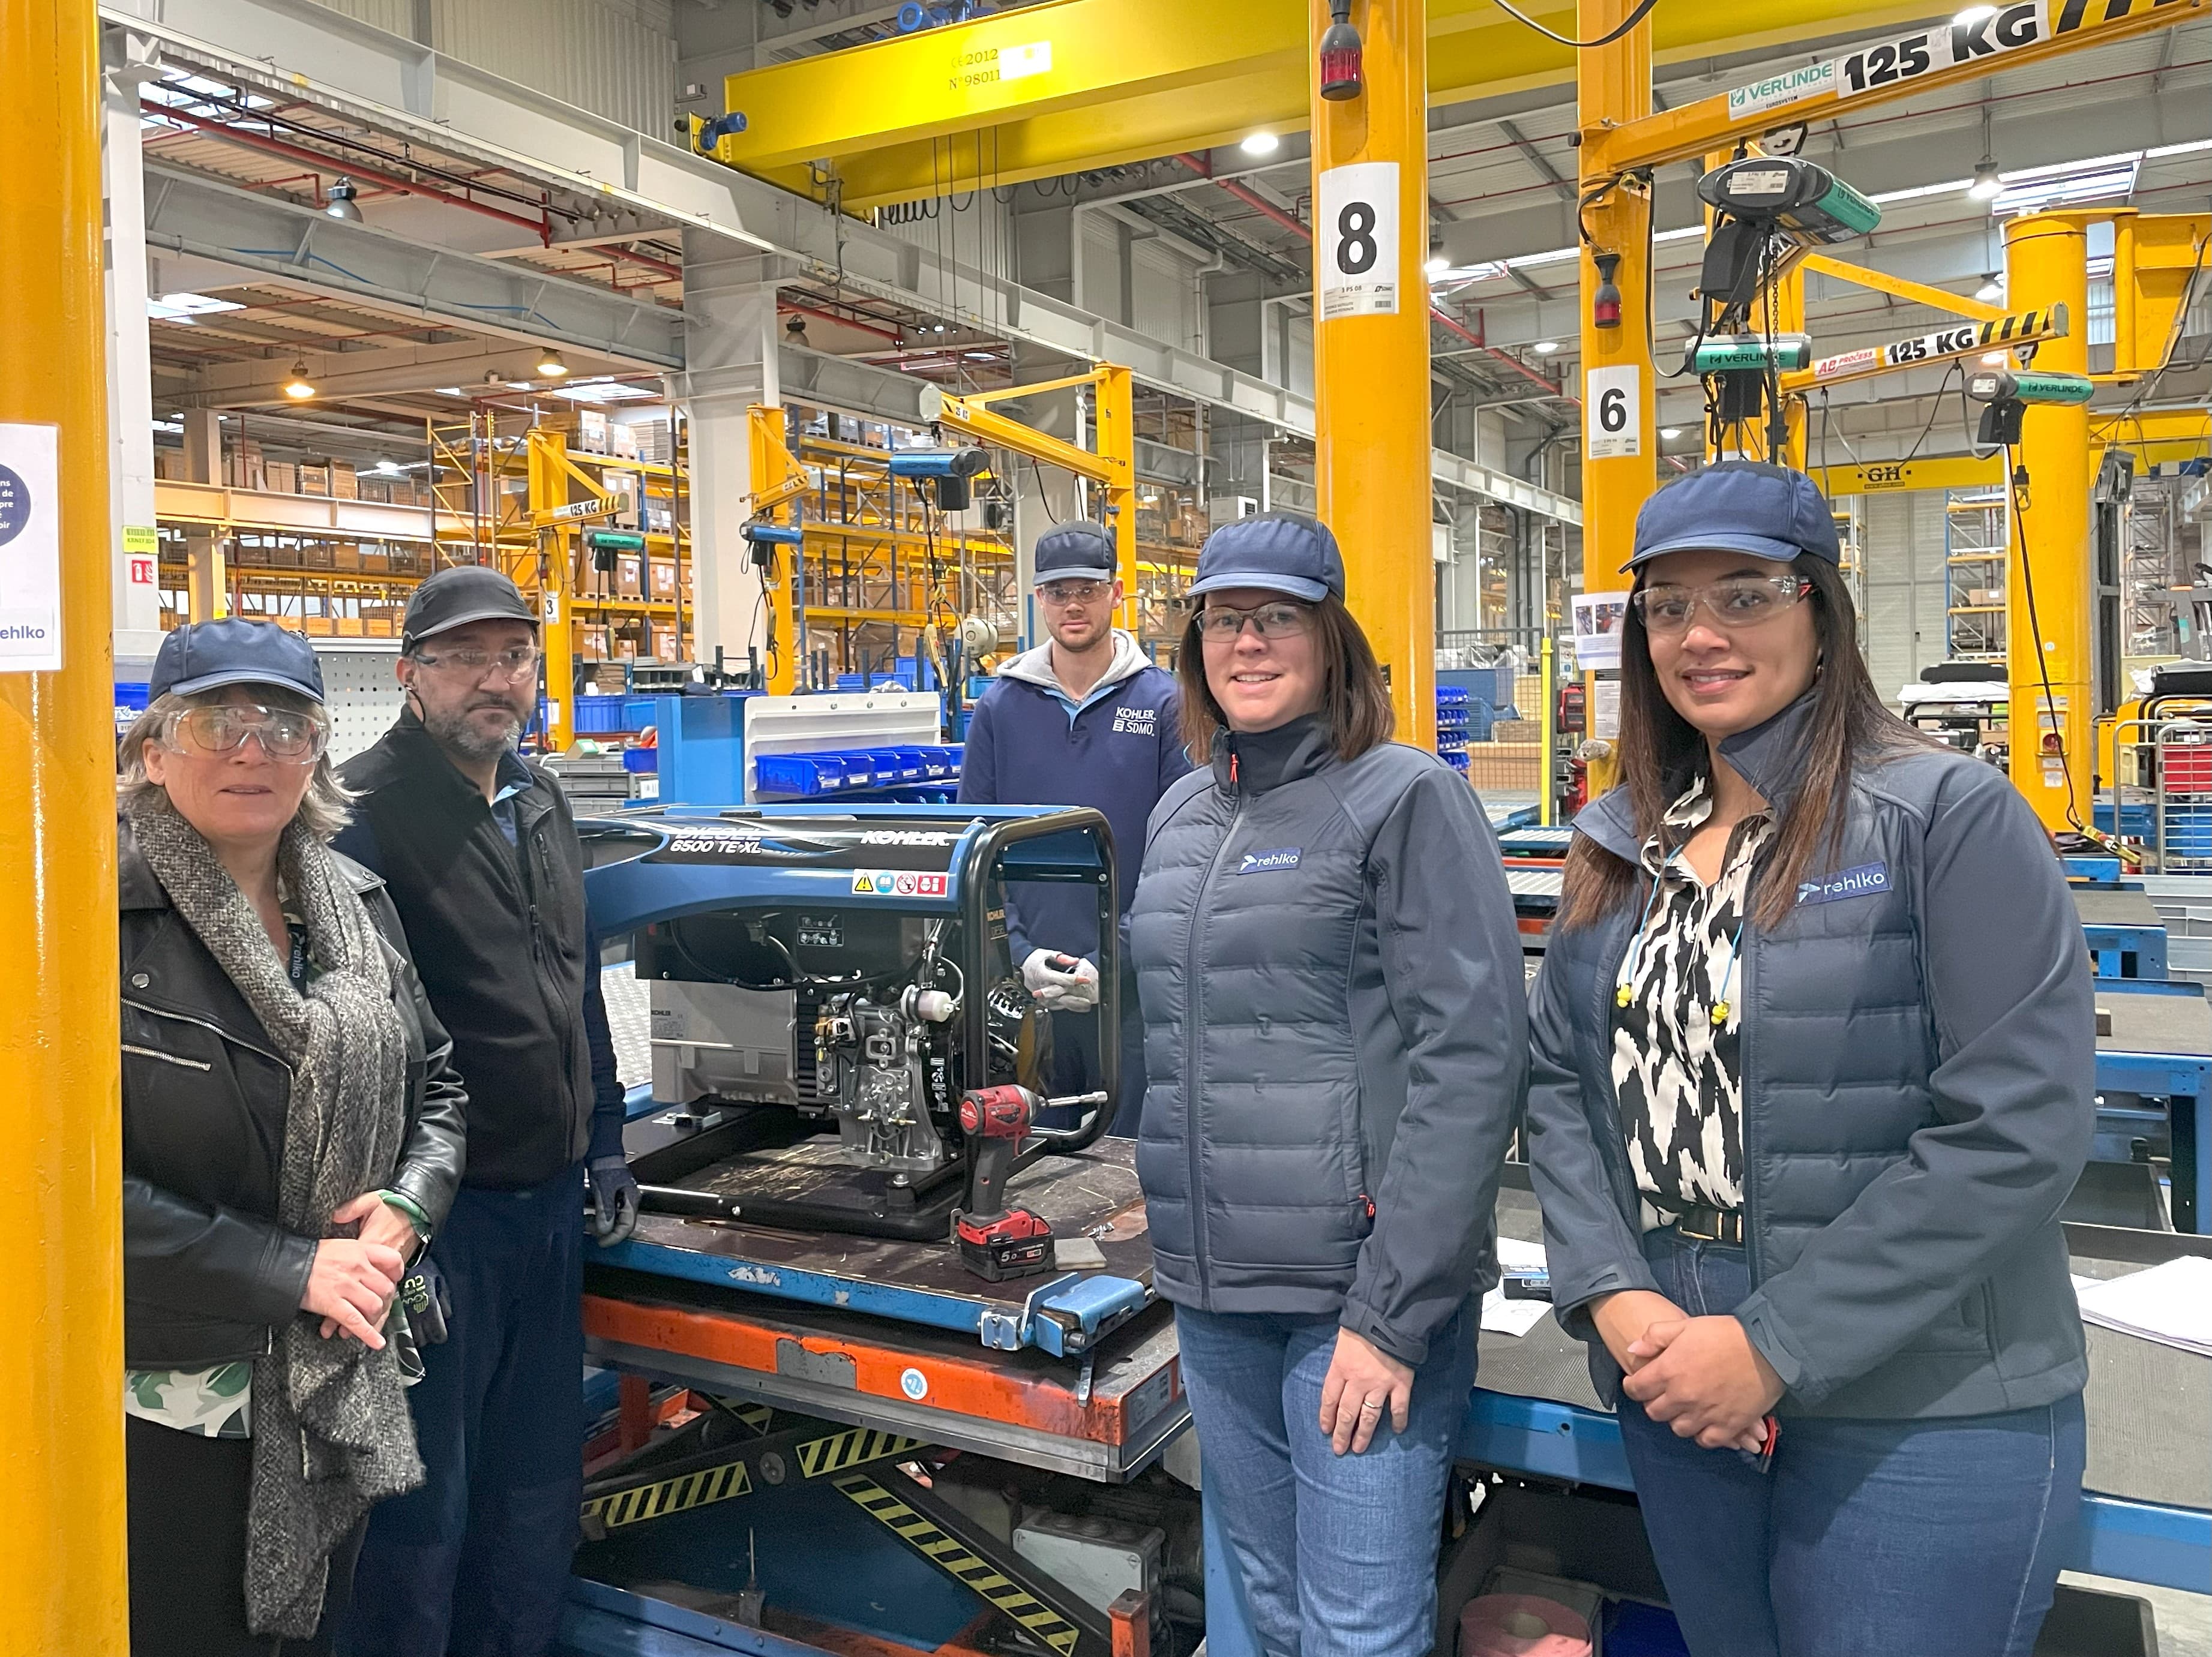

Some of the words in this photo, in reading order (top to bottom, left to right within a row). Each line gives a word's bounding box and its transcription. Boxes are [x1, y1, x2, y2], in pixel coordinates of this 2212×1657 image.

[1844, 34, 1930, 92] 125
[1951, 4, 2039, 62] KG
[965, 49, 999, 65] 2012
[1749, 63, 1832, 100] VERLINDE
[1766, 95, 1798, 109] EUROSYSTEM
[1336, 202, 1377, 275] 8
[1889, 338, 1926, 364] 125
[1937, 328, 1974, 354] KG
[1724, 352, 1786, 362] VERLINE
[1818, 360, 1836, 374] AB
[2039, 383, 2084, 393] VERLINDE
[1600, 388, 1627, 432] 6
[1868, 466, 1901, 482] GH
[2, 489, 14, 497] de
[570, 505, 582, 517] 125
[585, 501, 597, 514] KG
[546, 599, 553, 615] 3
[670, 840, 715, 852] 6500
[1257, 853, 1299, 867] rehlko
[1824, 872, 1885, 895] rehlko
[292, 945, 304, 978] rehlko
